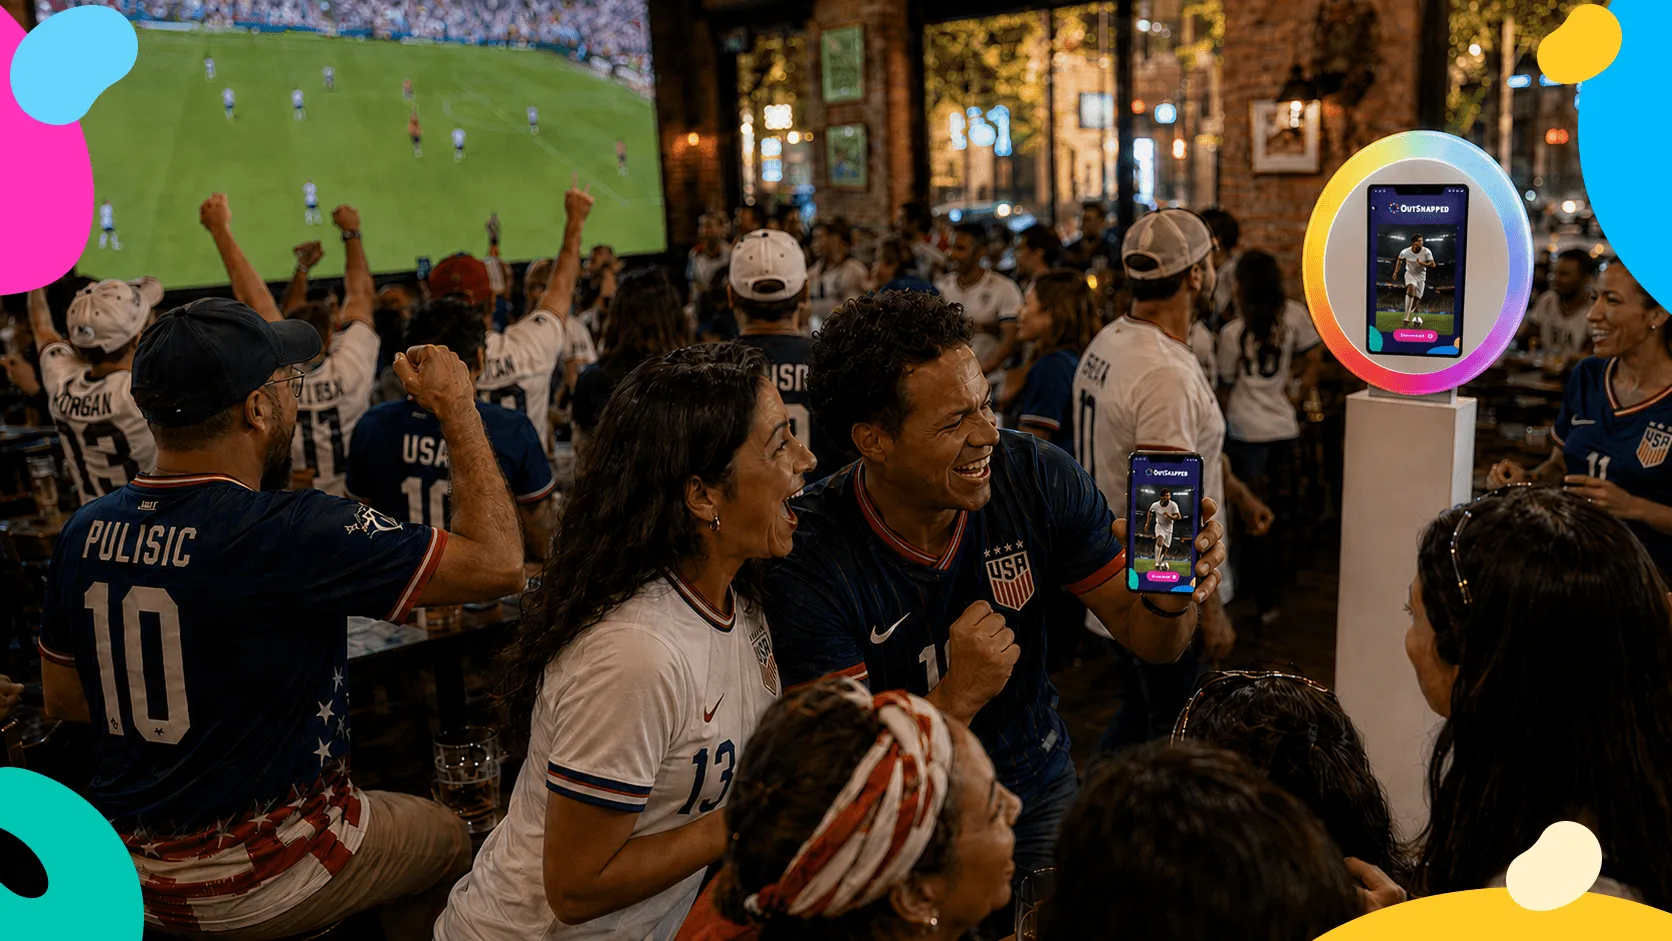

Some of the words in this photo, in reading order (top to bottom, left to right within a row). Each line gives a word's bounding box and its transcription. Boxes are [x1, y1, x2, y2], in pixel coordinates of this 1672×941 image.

[402, 433, 450, 468] USA
[1646, 430, 1671, 448] USA
[1586, 451, 1612, 481] 11
[82, 519, 197, 568] PULISIC
[987, 554, 1028, 581] USA
[84, 580, 192, 746] 10
[918, 639, 951, 692] 1
[677, 739, 736, 815] 13
